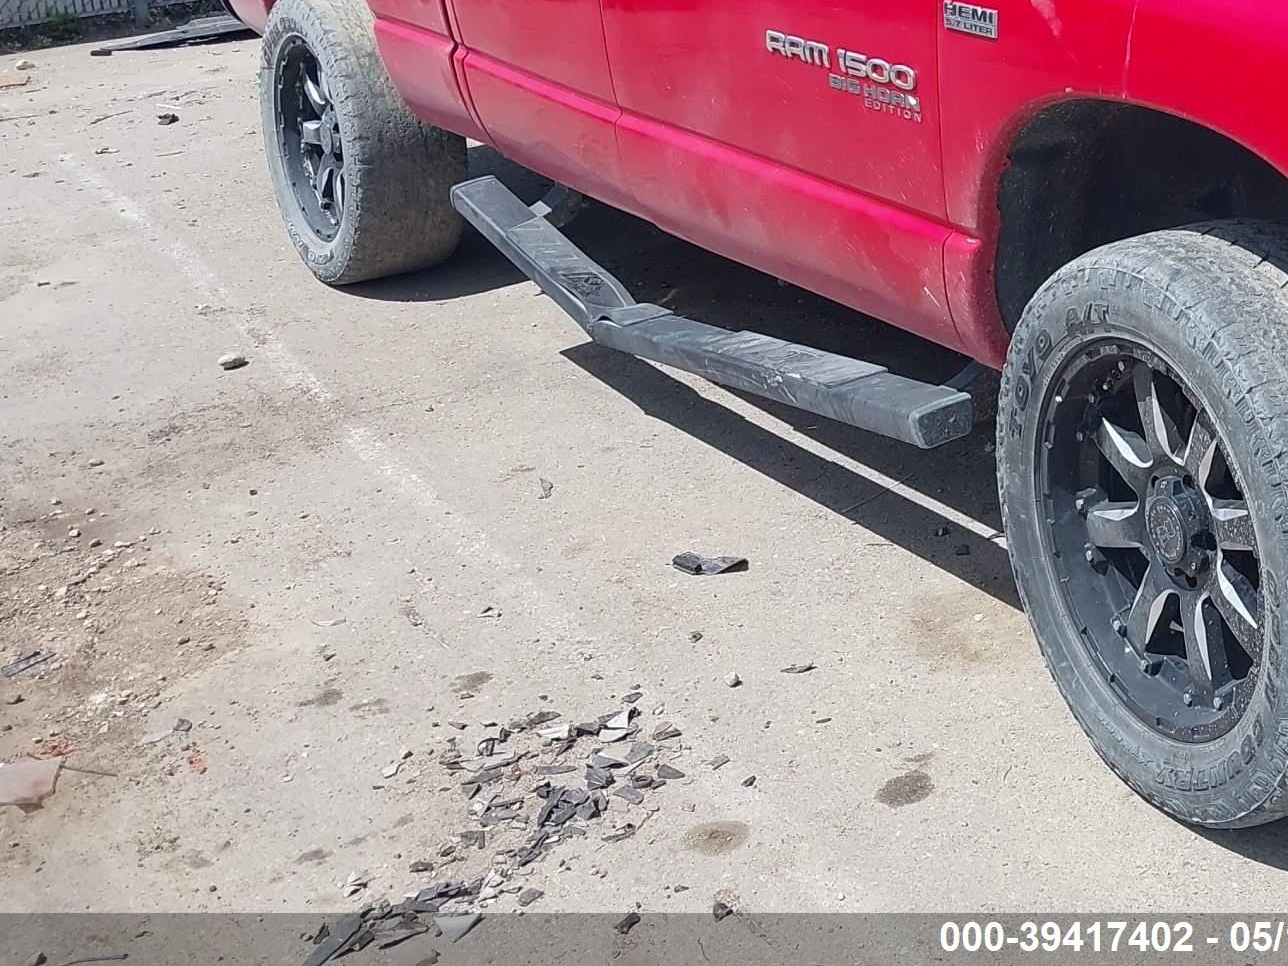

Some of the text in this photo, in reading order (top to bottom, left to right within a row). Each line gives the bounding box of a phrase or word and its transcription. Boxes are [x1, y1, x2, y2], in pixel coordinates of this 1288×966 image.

[943, 2, 994, 24] HEMI
[963, 22, 993, 36] LITER
[765, 29, 916, 90] RAM 1500
[828, 73, 920, 112] BIG HORN
[863, 98, 922, 123] EDITION
